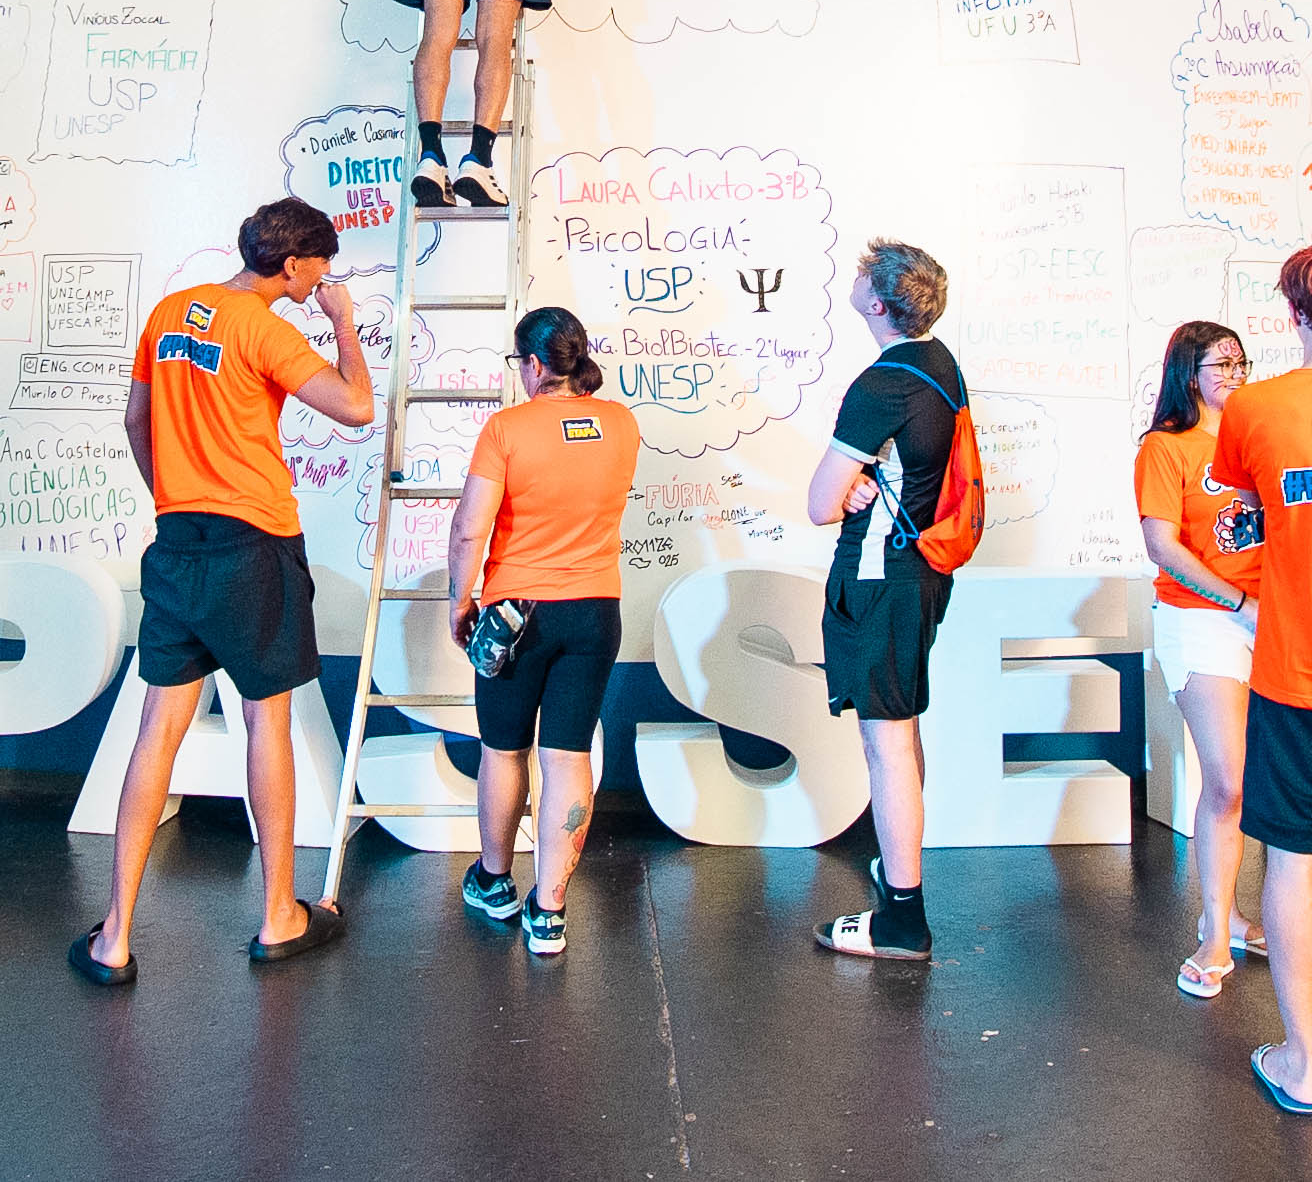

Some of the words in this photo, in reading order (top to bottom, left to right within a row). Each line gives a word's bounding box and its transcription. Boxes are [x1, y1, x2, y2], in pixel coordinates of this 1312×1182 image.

[968, 15, 1017, 38] UFU
[88, 74, 158, 113] USP
[54, 113, 126, 140] UNESP
[310, 125, 358, 154] Danielle
[346, 187, 390, 209] UEL
[333, 205, 395, 232] UNESP
[51, 265, 95, 284] USP
[625, 266, 693, 302] USP
[49, 287, 114, 302] UNICAMP
[21, 383, 58, 399] Murilo
[619, 363, 713, 400] UNESP
[0, 440, 32, 461] Ana
[404, 514, 445, 535] USP
[392, 538, 448, 559] UNES
